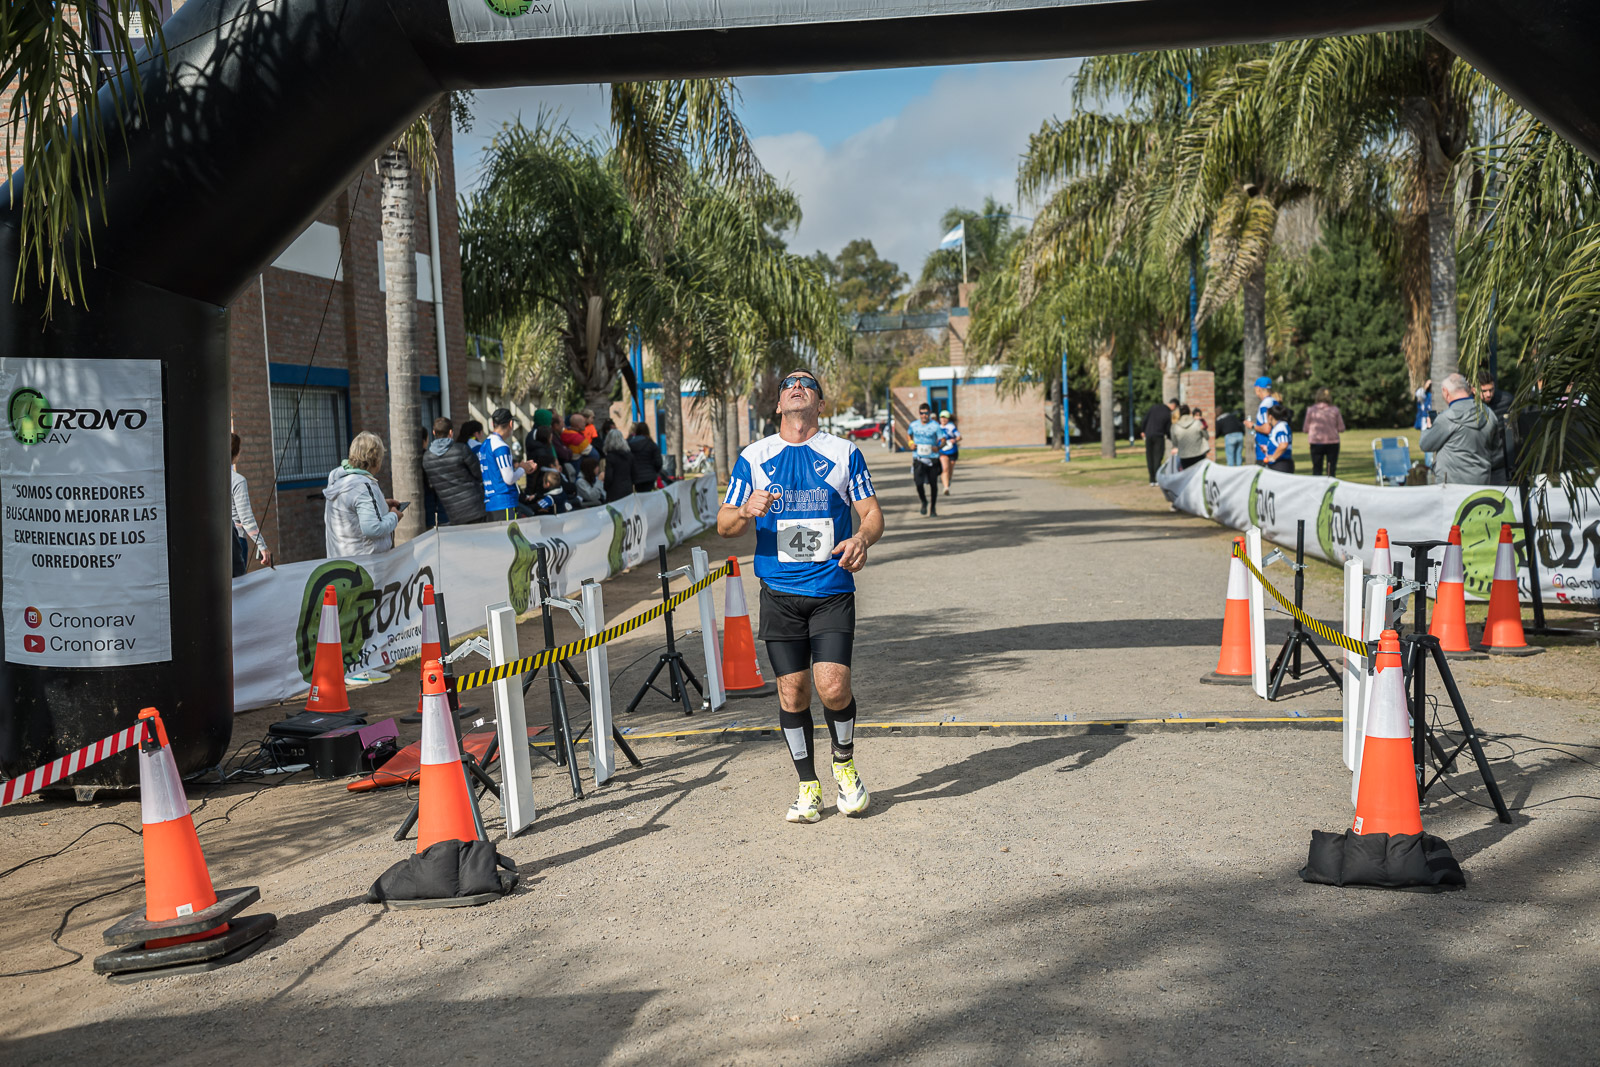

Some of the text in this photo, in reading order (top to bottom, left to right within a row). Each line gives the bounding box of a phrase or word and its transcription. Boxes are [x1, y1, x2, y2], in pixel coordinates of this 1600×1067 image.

[519, 4, 552, 15] RAV
[38, 408, 147, 430] CRONO
[36, 432, 72, 444] RAV
[55, 485, 145, 500] CORREDORES
[6, 506, 158, 523] BUSCANDO MEJORAR LAS
[14, 529, 146, 546] EXPERIENCIAS DE LOS
[789, 531, 822, 552] 43
[49, 612, 136, 628] Cronorav
[49, 636, 137, 652] Cronorav
